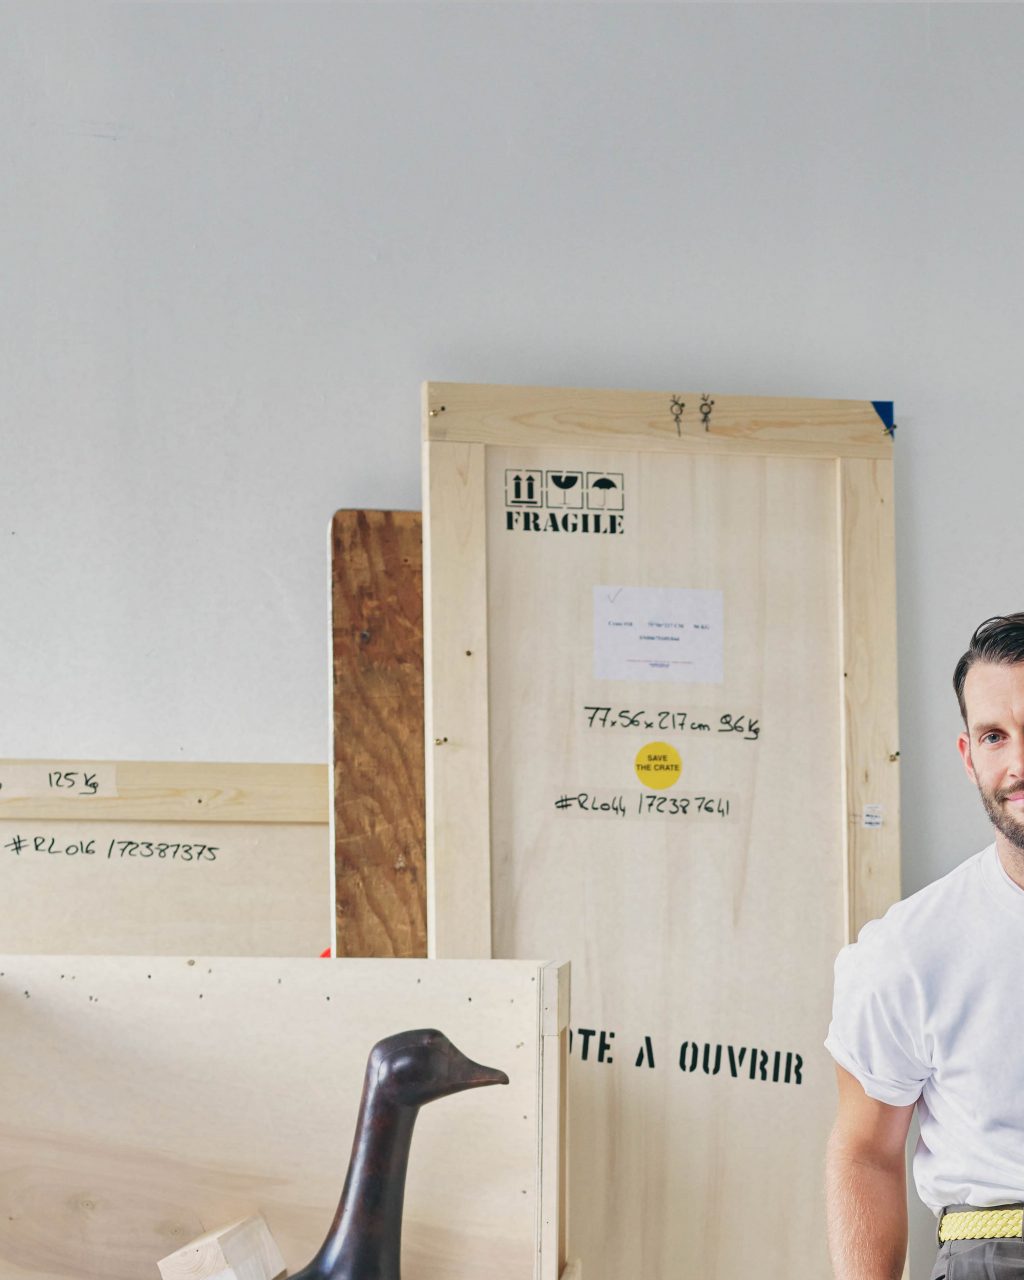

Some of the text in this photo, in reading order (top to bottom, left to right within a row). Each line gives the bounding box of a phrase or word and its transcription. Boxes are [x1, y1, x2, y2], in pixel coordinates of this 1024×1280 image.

[506, 511, 624, 534] FRAGILE
[647, 754, 668, 762] SAVE
[636, 763, 680, 772] THE CRATE
[48, 772, 78, 788] 125
[569, 1028, 804, 1085] TE A OUVRIR
